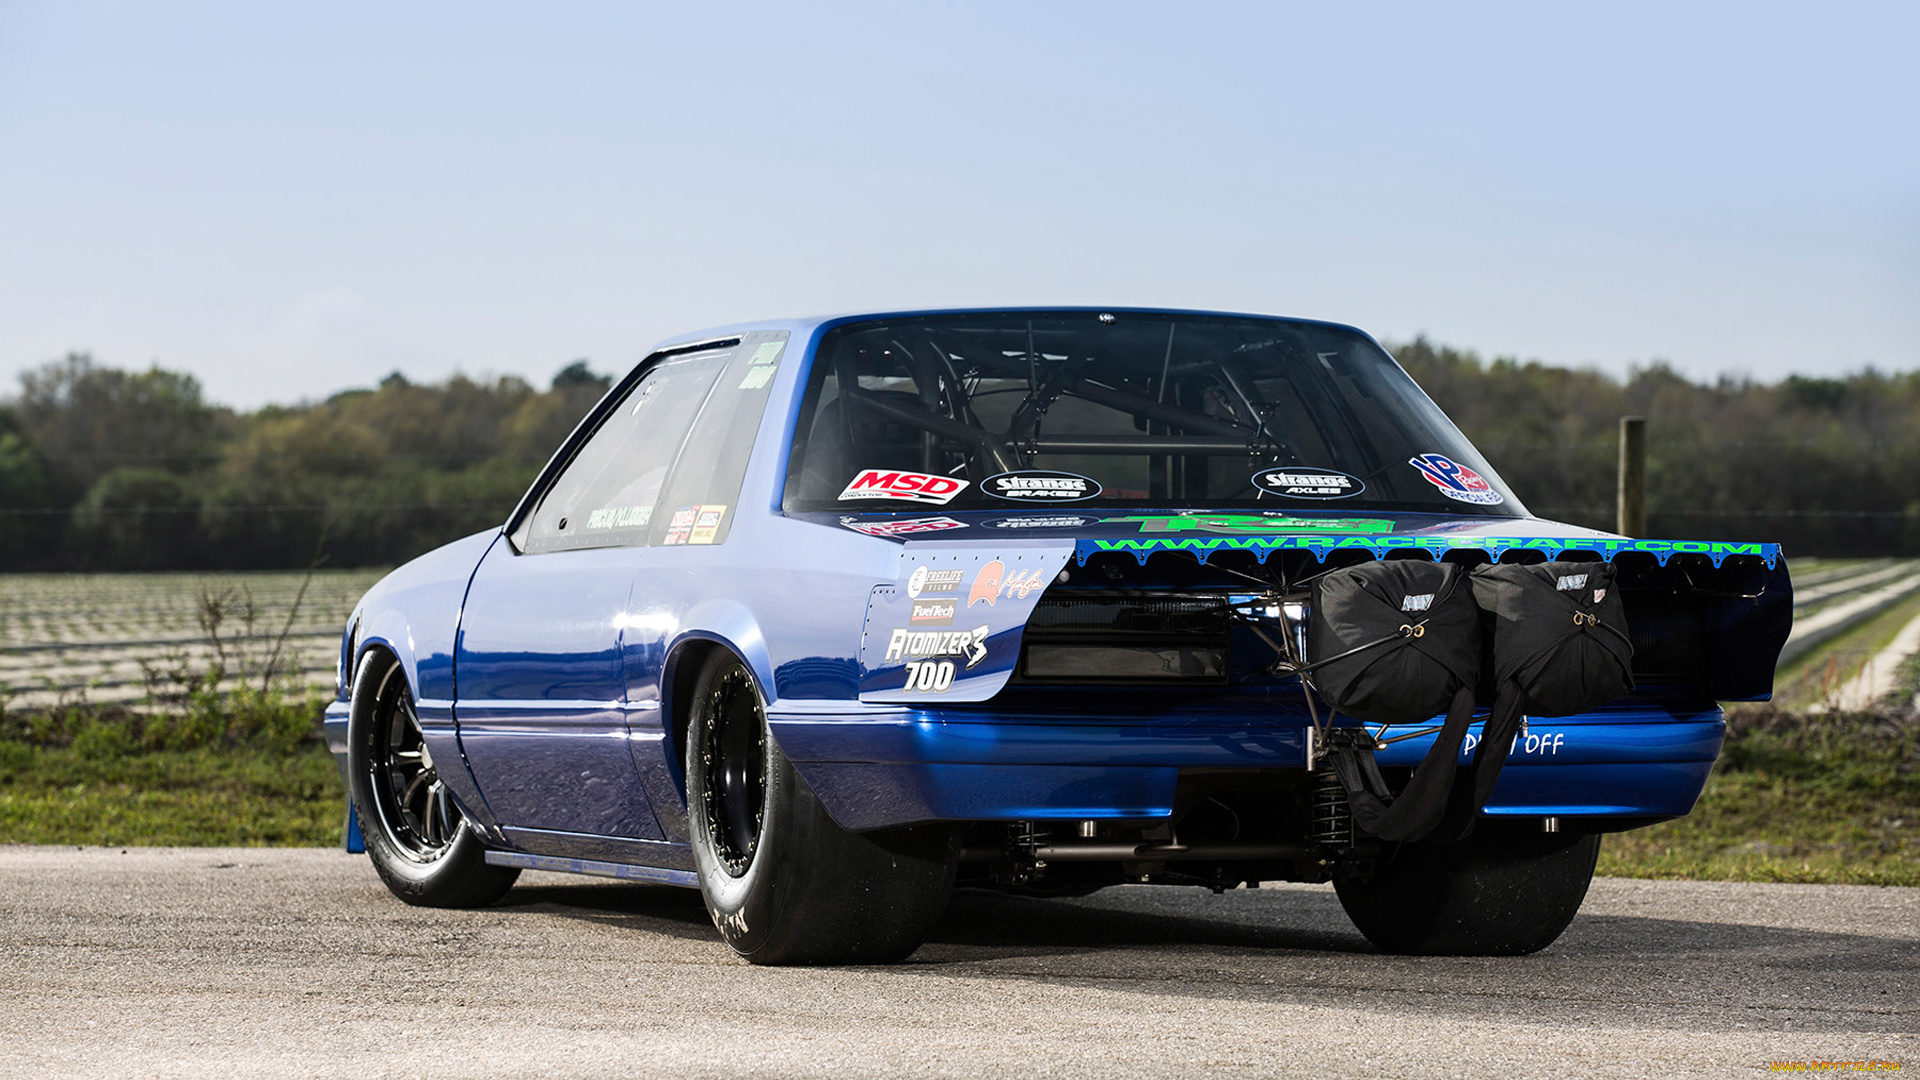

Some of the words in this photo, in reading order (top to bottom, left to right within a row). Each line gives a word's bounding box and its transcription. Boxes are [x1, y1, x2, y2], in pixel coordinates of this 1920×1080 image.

[851, 472, 959, 494] MSD
[997, 476, 1087, 490] Strange
[1266, 473, 1351, 487] Strange
[1094, 537, 1761, 553] WWW.RACECRAFT.COM
[926, 570, 963, 582] FREELIFE
[912, 605, 954, 618] FuelTech
[903, 661, 956, 694] 700
[1525, 733, 1564, 755] OFF
